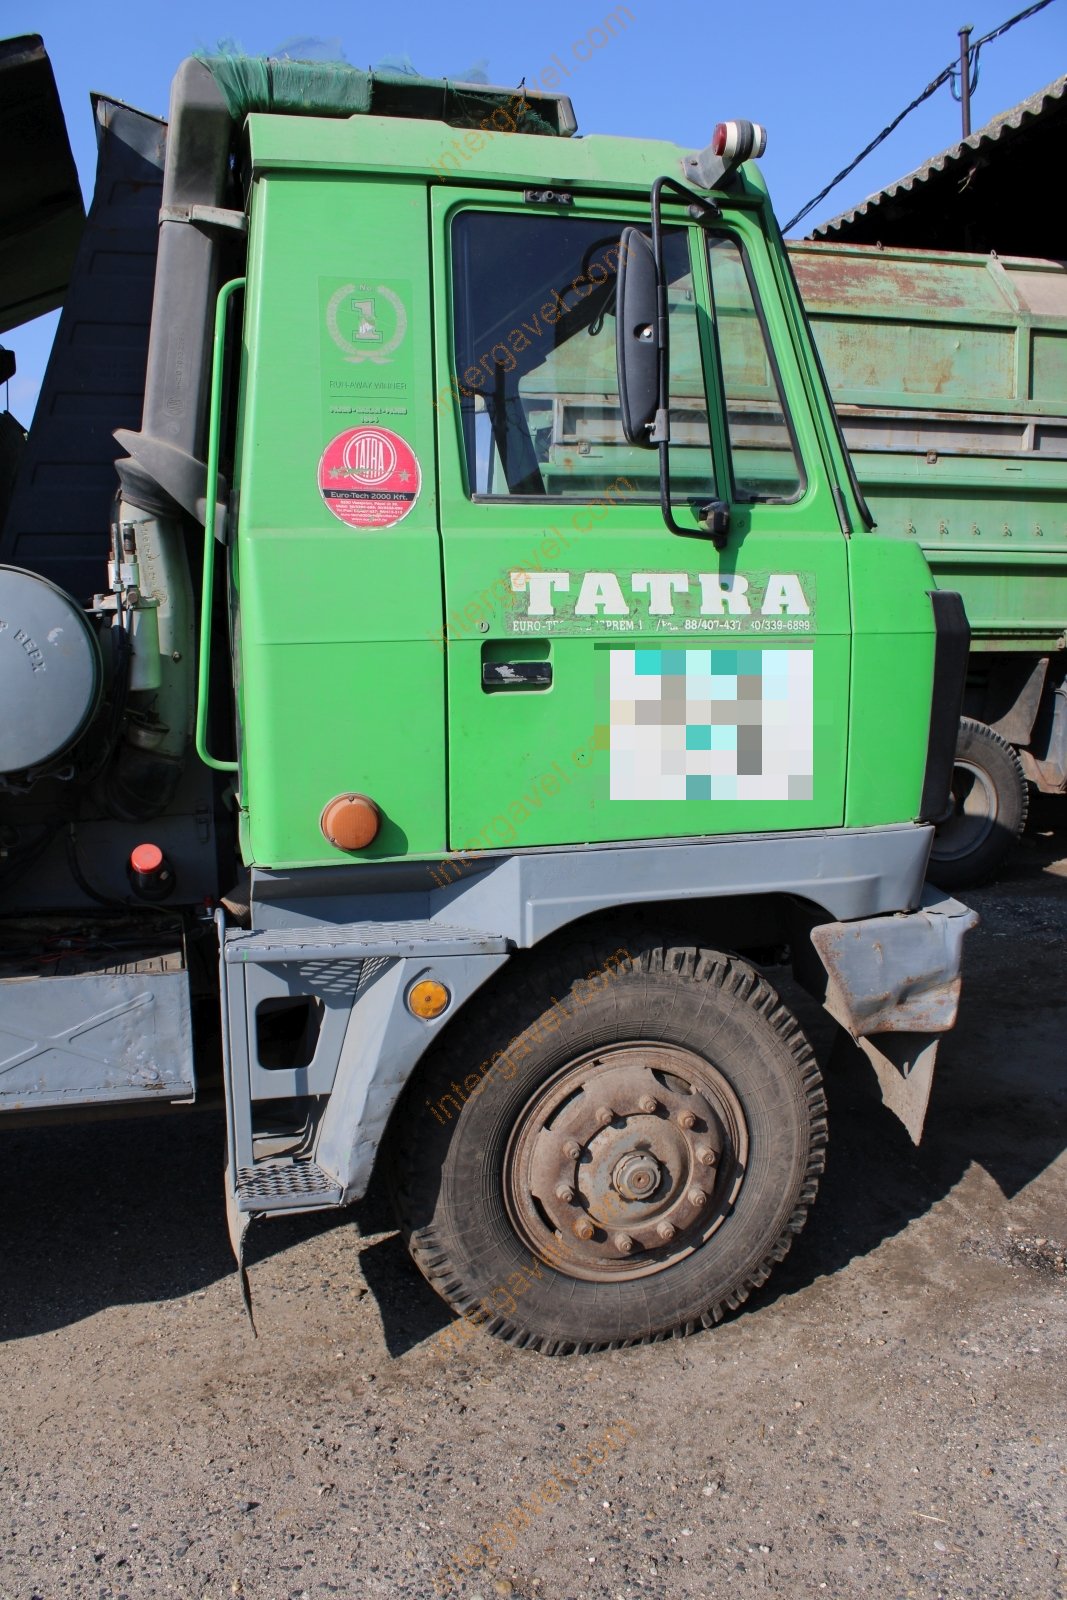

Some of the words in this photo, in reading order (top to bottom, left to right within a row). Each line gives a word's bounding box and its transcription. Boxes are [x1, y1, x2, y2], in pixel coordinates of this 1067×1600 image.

[355, 437, 385, 478] TATRA
[330, 491, 370, 499] Euro-Tech
[510, 572, 810, 615] TATRA
